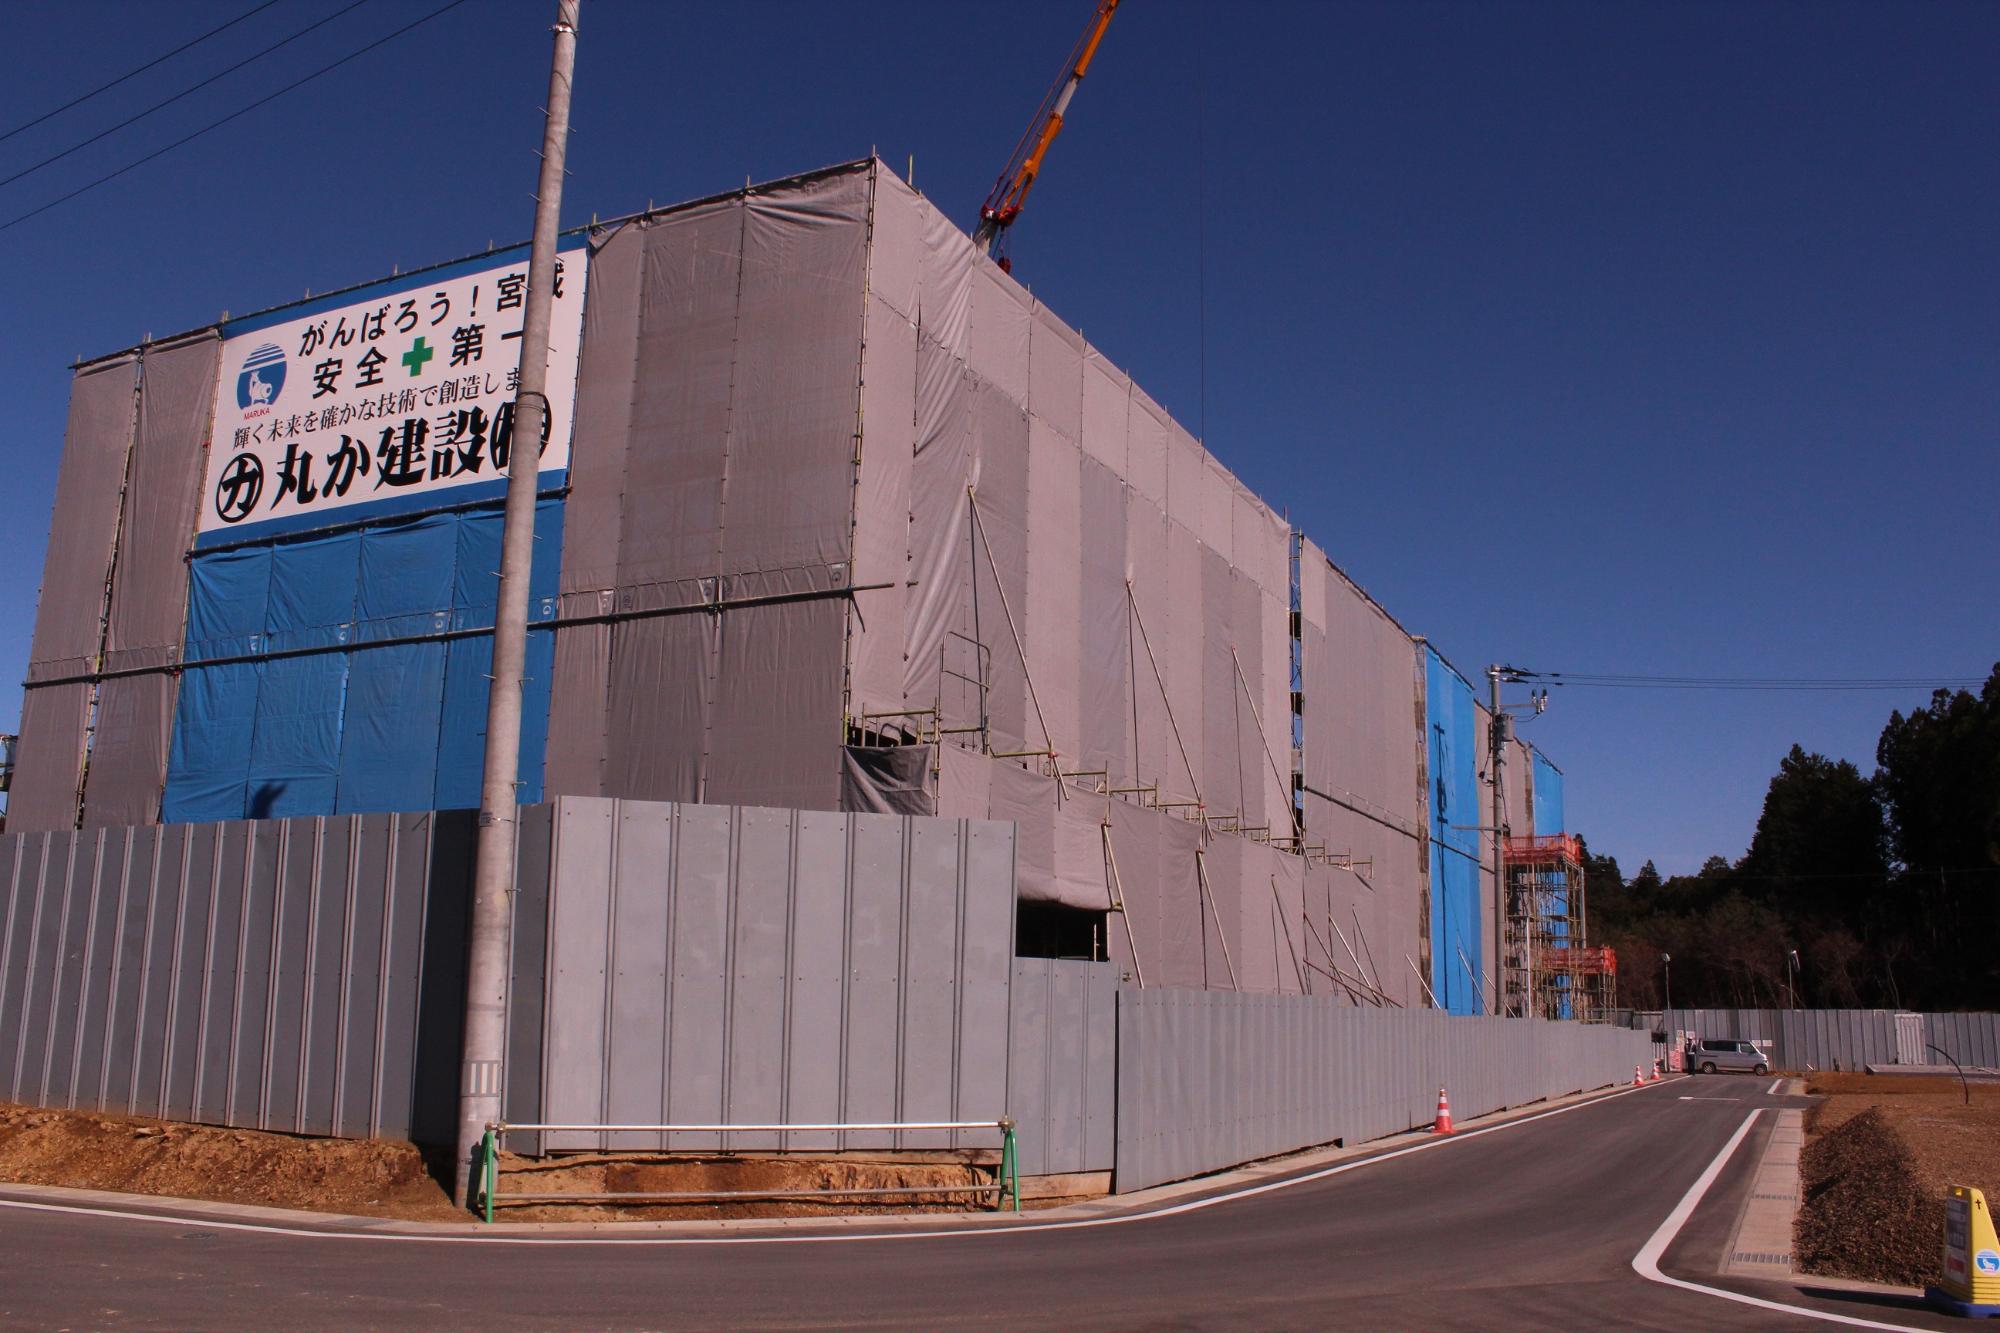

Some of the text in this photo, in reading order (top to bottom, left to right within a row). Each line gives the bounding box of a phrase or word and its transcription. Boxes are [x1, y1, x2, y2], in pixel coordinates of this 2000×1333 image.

[232, 364, 549, 450] 輝く未来を確かな技術で創造しま
[312, 346, 389, 400] 安全
